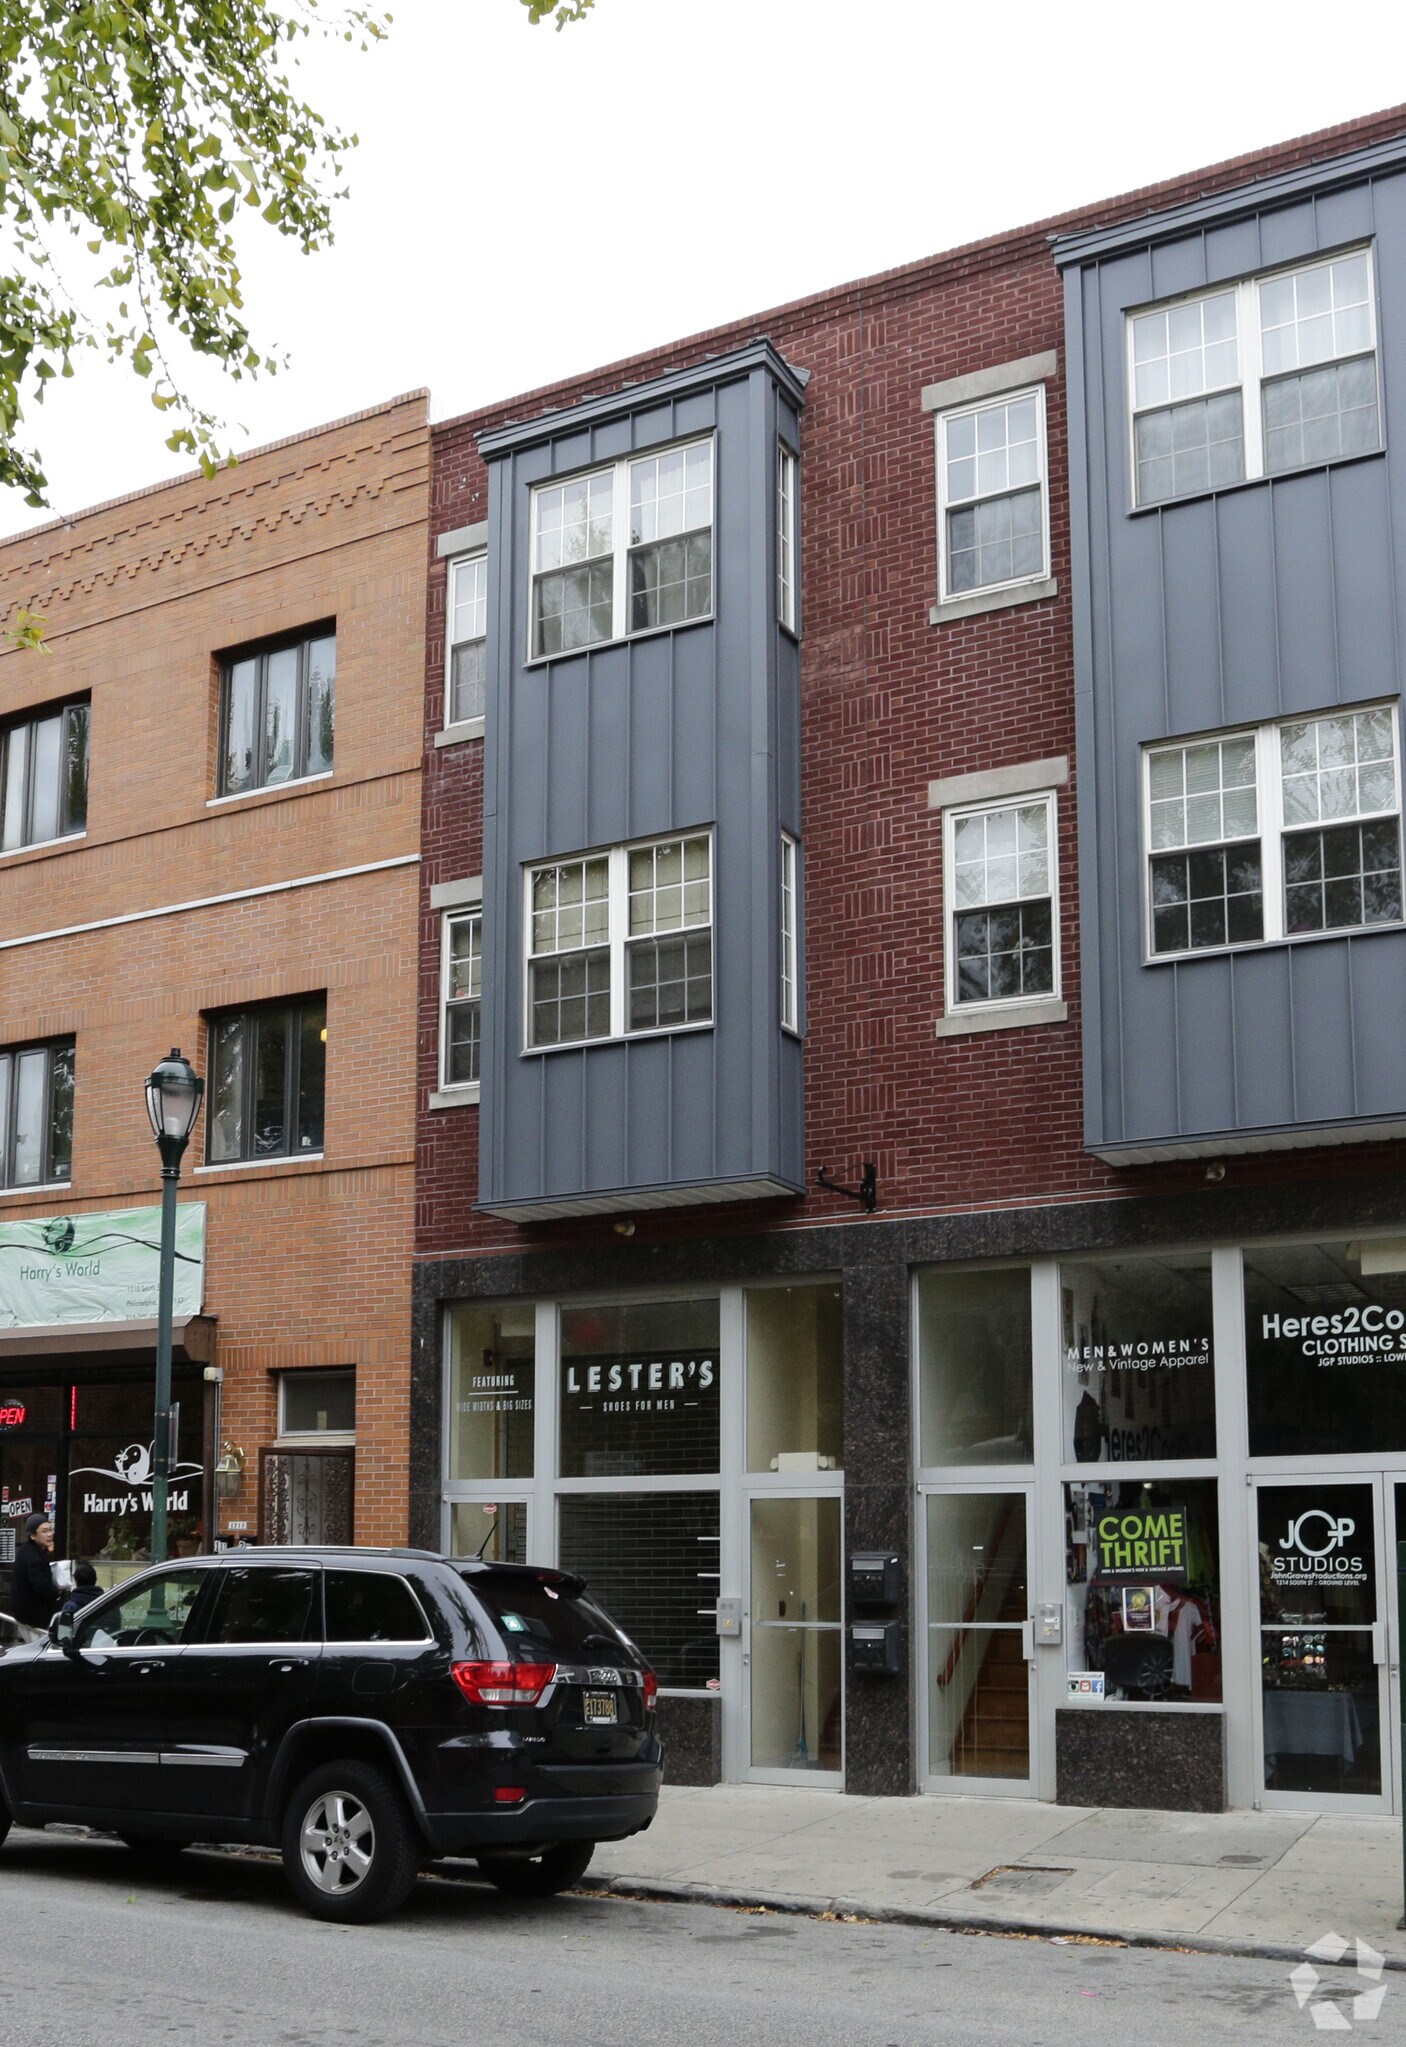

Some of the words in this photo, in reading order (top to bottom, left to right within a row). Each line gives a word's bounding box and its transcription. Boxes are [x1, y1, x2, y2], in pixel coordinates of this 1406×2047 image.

[20, 1263, 62, 1283] Harry's
[65, 1260, 101, 1276] World
[1262, 1305, 1405, 1339] Heres2Co
[1302, 1334, 1394, 1356] CLOTHING
[1067, 1362, 1094, 1373] New
[1097, 1361, 1106, 1371] &
[1109, 1358, 1156, 1371] Vintage
[1159, 1353, 1209, 1369] Apparel
[1317, 1357, 1335, 1367] JGP
[1337, 1355, 1374, 1366] STUDIOS
[472, 1374, 515, 1388] FEATURING
[567, 1360, 714, 1393] LESTER'S
[472, 1400, 494, 1412] WIDTHS
[515, 1399, 532, 1410] SIZES
[603, 1401, 631, 1412] SHOES
[635, 1400, 651, 1411] FOR
[656, 1399, 675, 1410] MEN
[9, 1500, 32, 1517] OPEN
[83, 1492, 138, 1516] Harry's
[142, 1490, 189, 1511] Wrld
[1099, 1514, 1183, 1541] COME
[1100, 1539, 1184, 1567] THRIFT
[1273, 1557, 1363, 1572] STUDIOS
[1270, 1571, 1367, 1581] JohnGravesProductions.org
